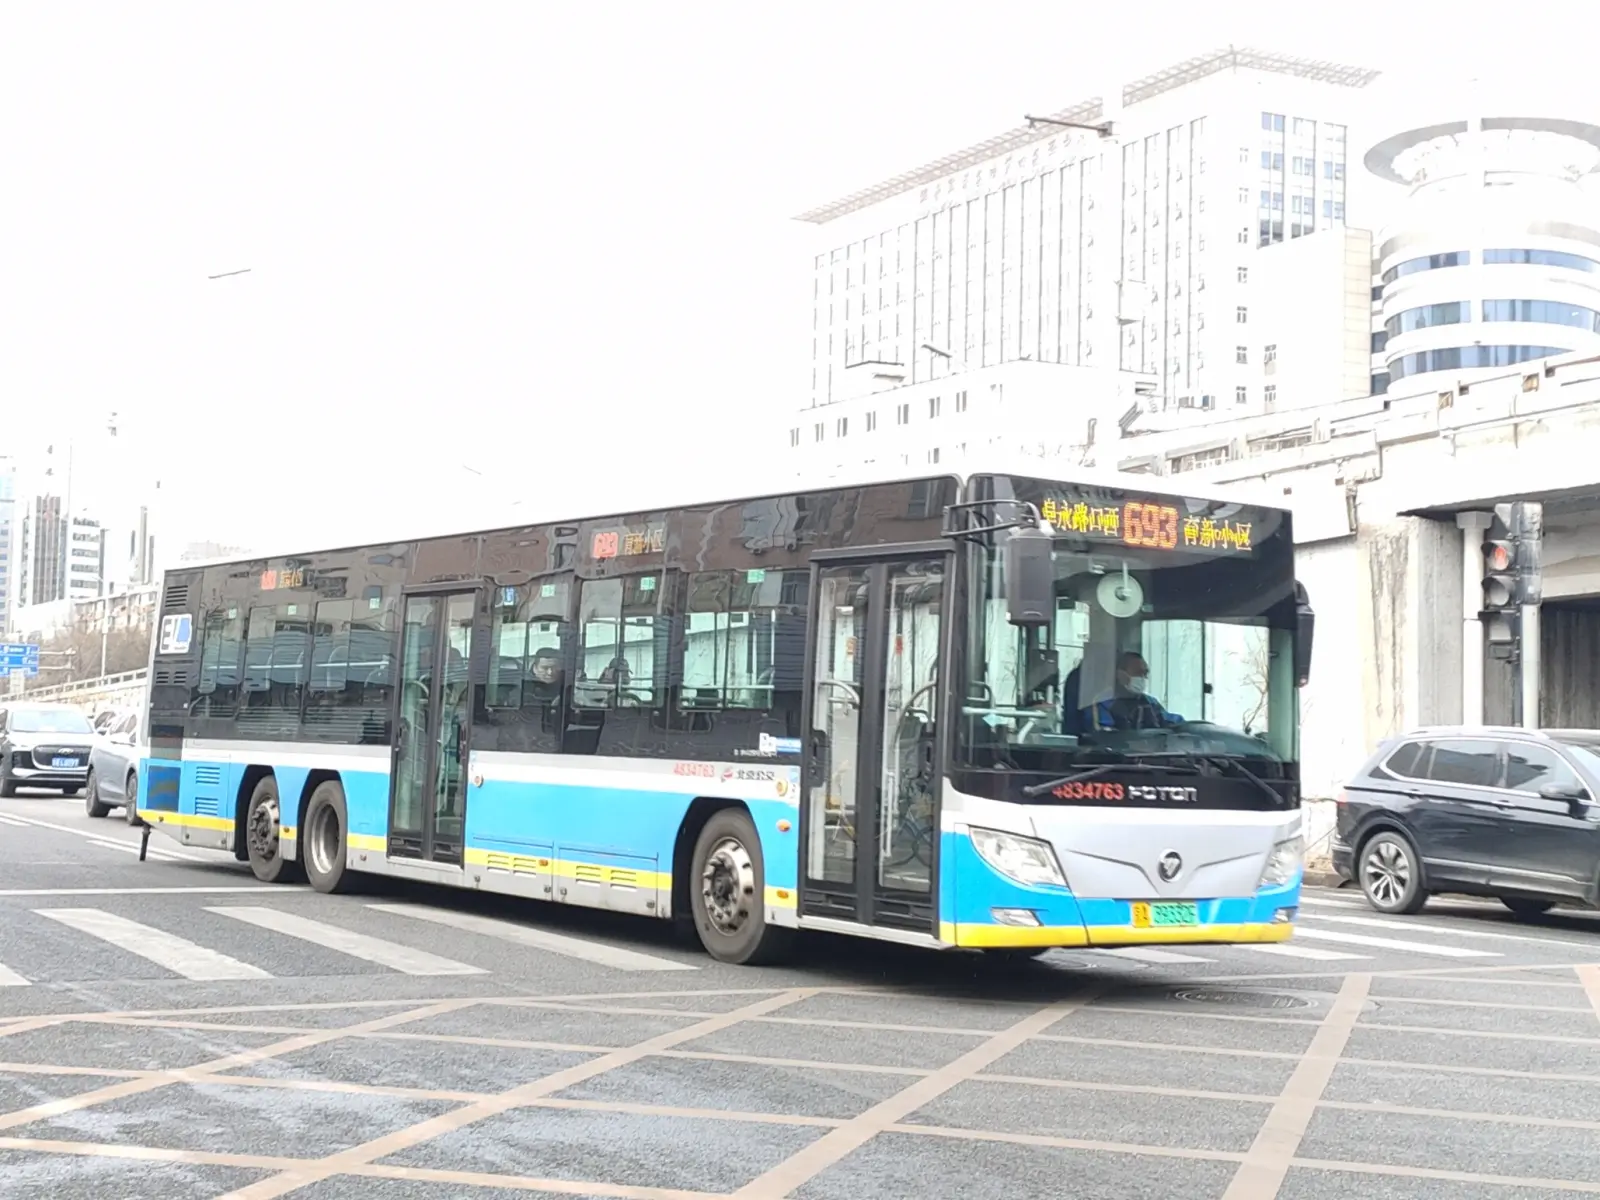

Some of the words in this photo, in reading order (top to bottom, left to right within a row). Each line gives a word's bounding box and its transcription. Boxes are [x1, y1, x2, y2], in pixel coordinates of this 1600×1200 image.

[1041, 497, 1119, 537] 阜永路口西
[1123, 501, 1178, 549] 693
[1183, 515, 1252, 551] 育新小区
[673, 763, 715, 777] 4834763
[1052, 782, 1124, 800] 4834763
[1128, 785, 1198, 801] FOTON
